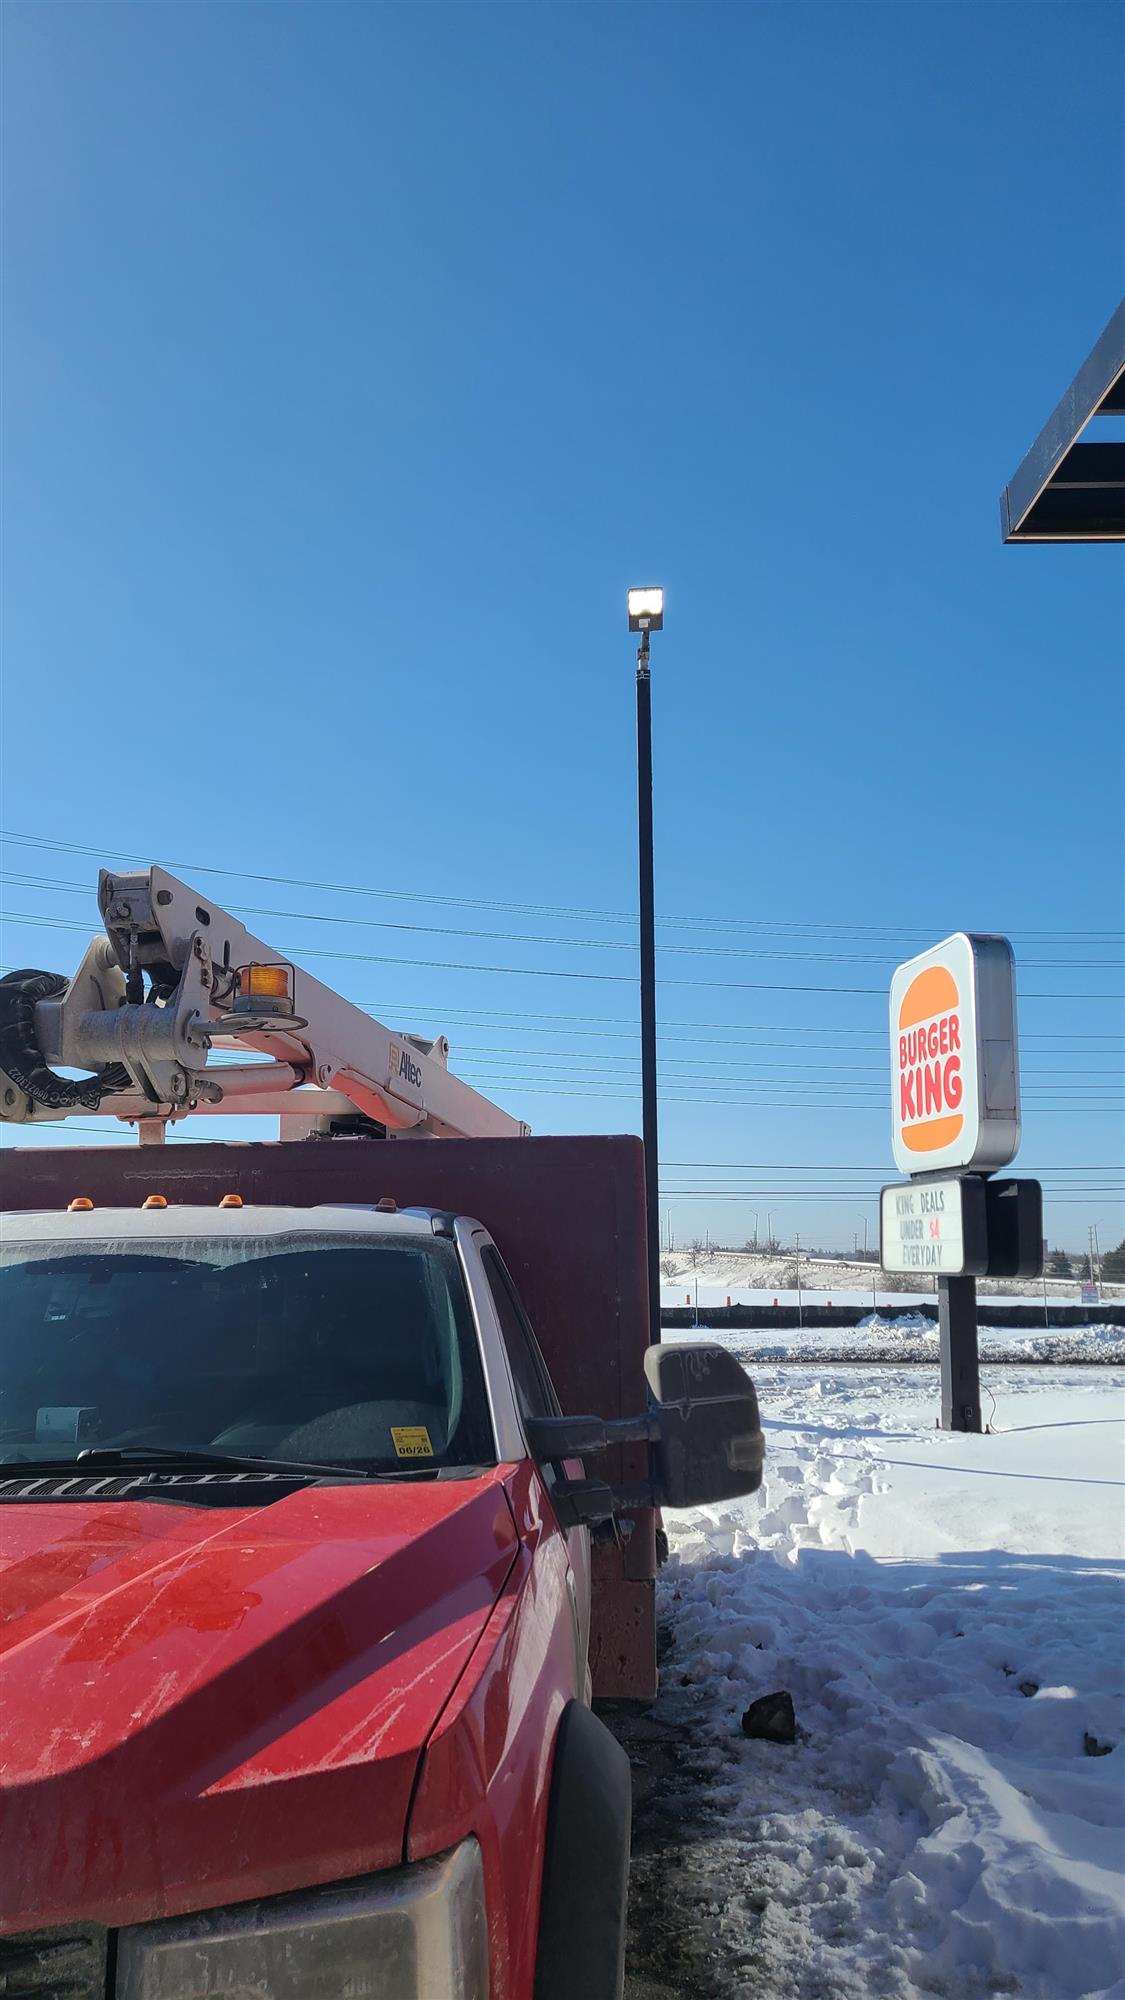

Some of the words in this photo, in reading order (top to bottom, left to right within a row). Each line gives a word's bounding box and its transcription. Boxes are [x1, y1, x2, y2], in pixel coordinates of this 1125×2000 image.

[899, 1013, 961, 1070] BURGER
[398, 1051, 422, 1088] Altec
[900, 1055, 963, 1122] KING
[896, 1194, 915, 1216] KING
[921, 1191, 945, 1214] DEALS
[900, 1219, 924, 1241] UNDER
[930, 1216, 941, 1239] $4
[903, 1244, 943, 1267] EVERYDAY
[399, 1446, 430, 1455] 06/26
